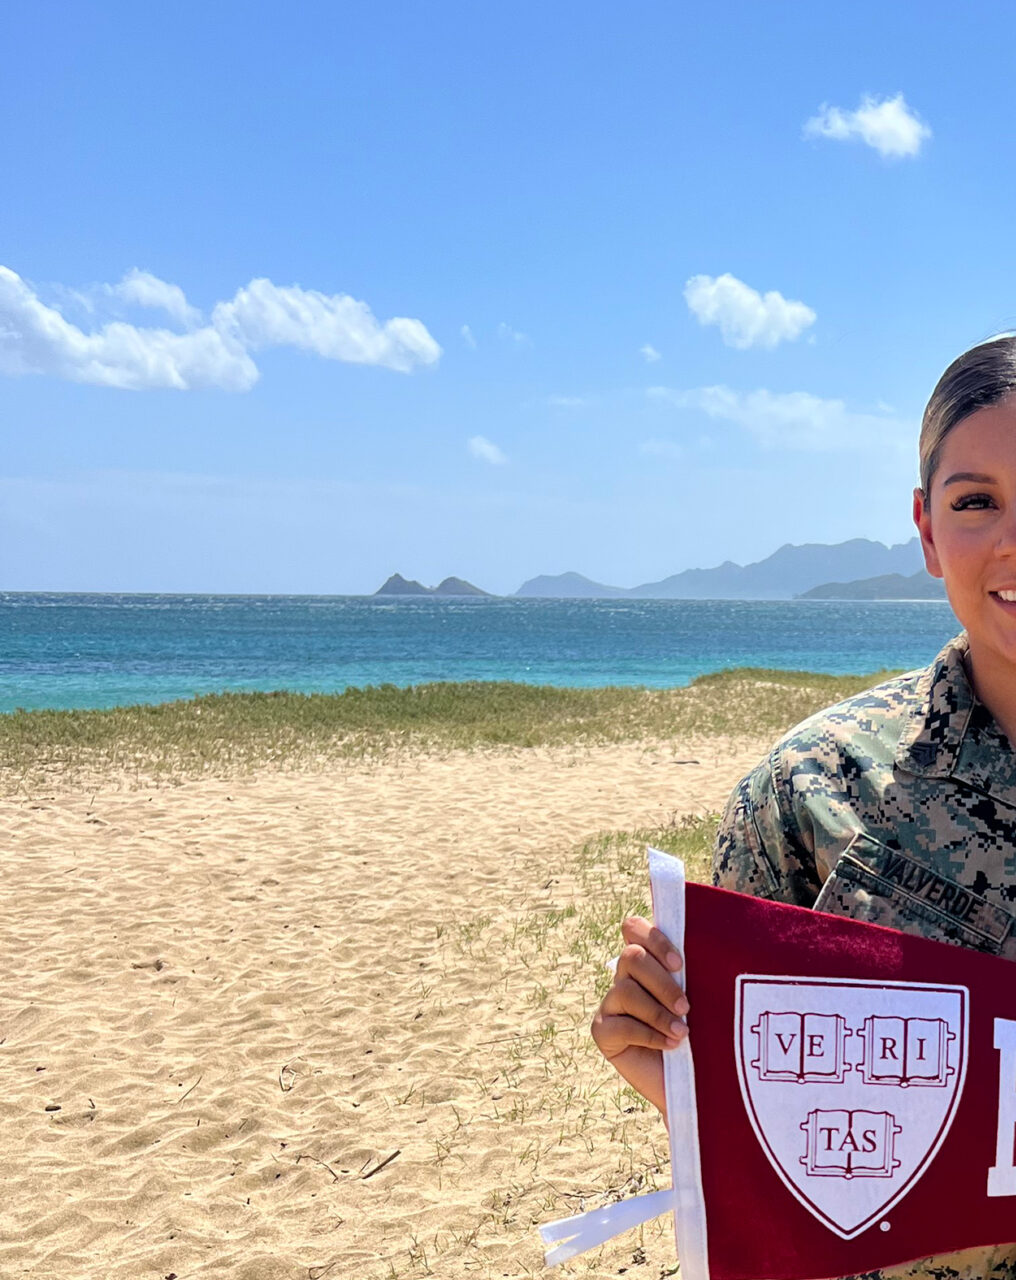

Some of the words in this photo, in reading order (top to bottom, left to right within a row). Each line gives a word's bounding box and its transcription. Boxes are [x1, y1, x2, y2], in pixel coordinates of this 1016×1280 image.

[880, 850, 984, 923] VALVERDE
[775, 1033, 825, 1057] VE
[880, 1037, 927, 1061] RI
[820, 1127, 878, 1153] TAS
